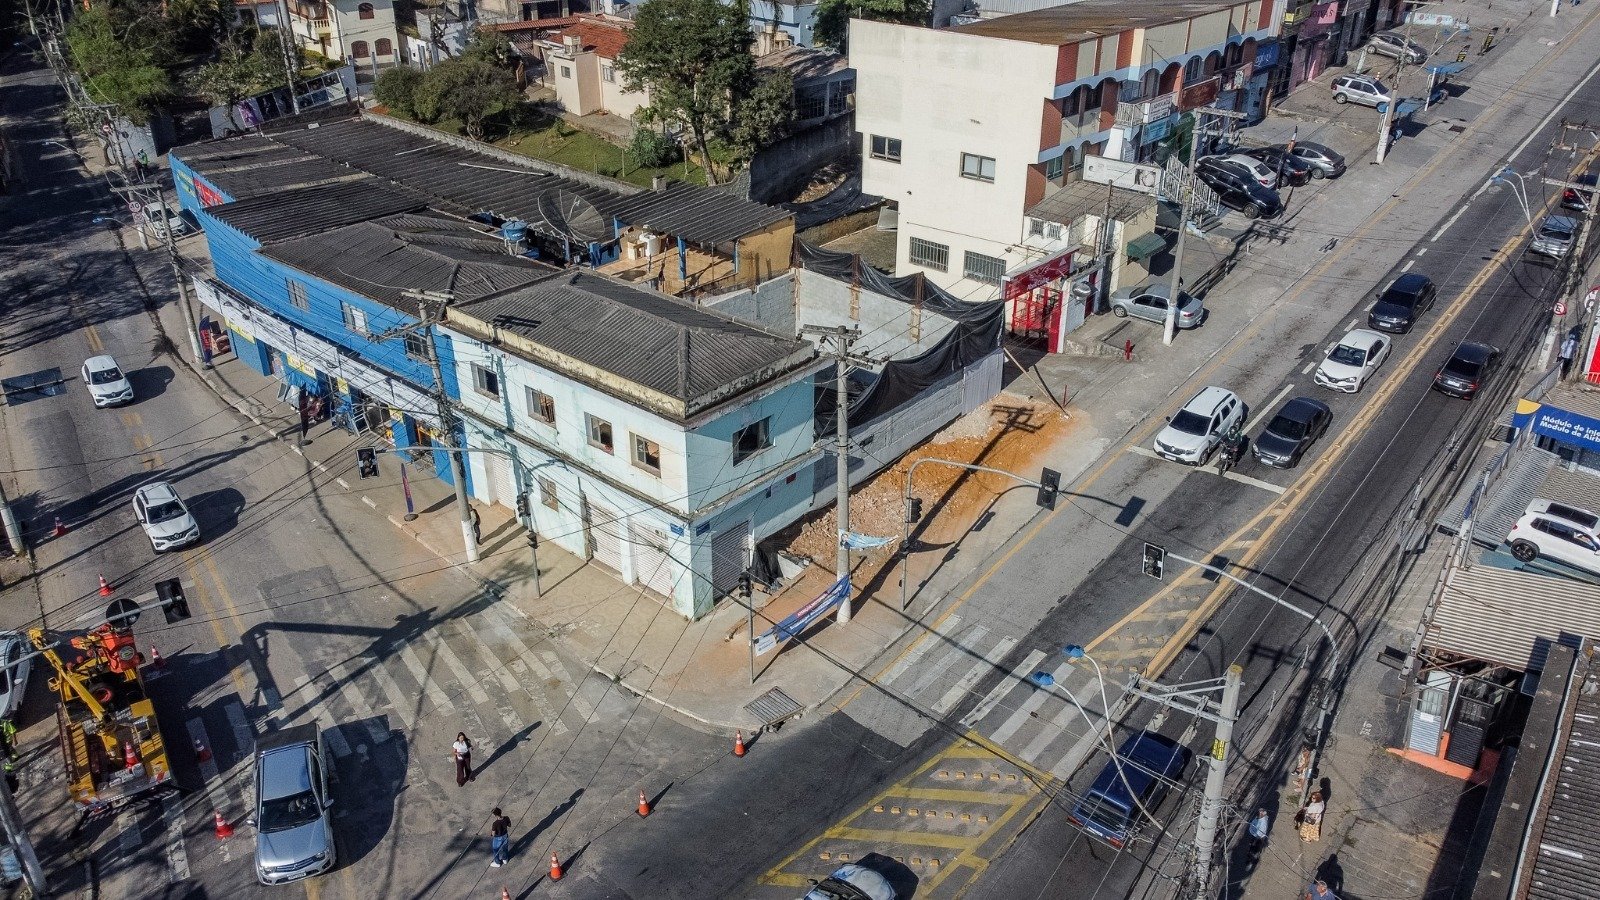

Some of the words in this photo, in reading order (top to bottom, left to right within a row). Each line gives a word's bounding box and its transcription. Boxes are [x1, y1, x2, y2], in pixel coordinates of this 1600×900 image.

[1540, 421, 1570, 433] Modulo
[1583, 433, 1600, 442] Airb
[1542, 415, 1572, 428] Módulo
[1573, 424, 1585, 432] de
